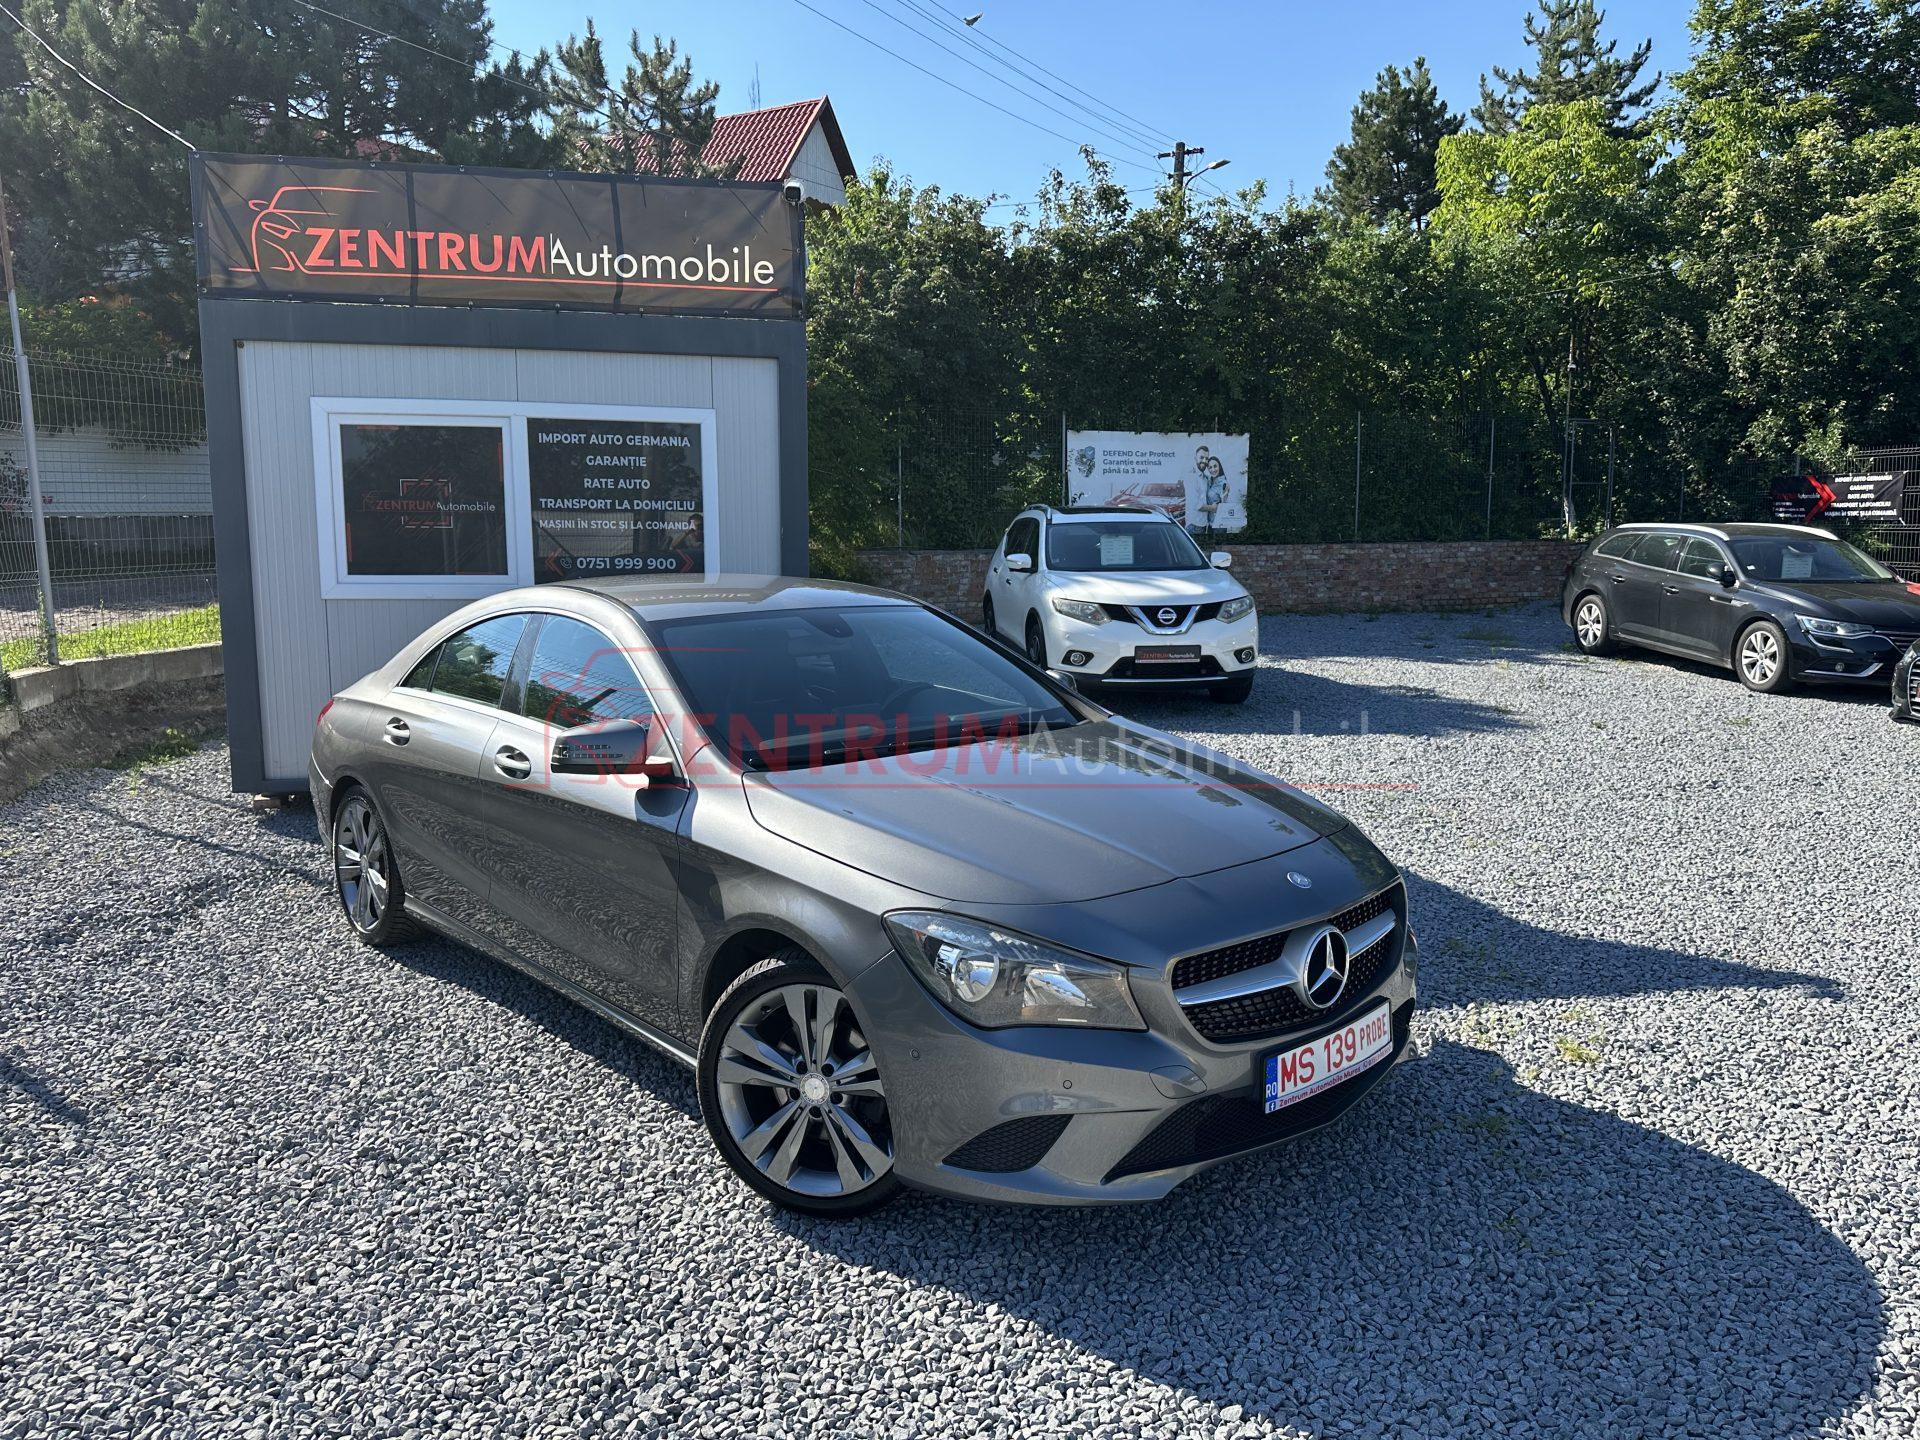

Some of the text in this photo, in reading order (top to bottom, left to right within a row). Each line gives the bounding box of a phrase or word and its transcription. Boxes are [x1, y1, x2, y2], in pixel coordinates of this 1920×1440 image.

[304, 227, 775, 285] ZENTRUM Automobile
[538, 433, 691, 447] IMPORT AUTO GERMANIA
[586, 456, 647, 469] GARANȚIE
[584, 478, 650, 489] RATE AUTO
[437, 501, 496, 512] Automobile
[539, 498, 695, 511] TRANSPORT LA DOMICILIU
[539, 519, 575, 531] MAȘINI
[577, 518, 589, 529] ÎN
[590, 520, 616, 529] STOC
[631, 521, 643, 529] LA
[646, 519, 696, 530] COMANDĂ
[576, 557, 676, 570] 0751 999 900
[1281, 1047, 1315, 1093] MS
[1324, 1028, 1357, 1073] 139
[1360, 1013, 1388, 1050] PROBE
[1266, 1082, 1277, 1098] RO
[1280, 1091, 1308, 1106] Zentrum
[1309, 1074, 1344, 1095] Automobile
